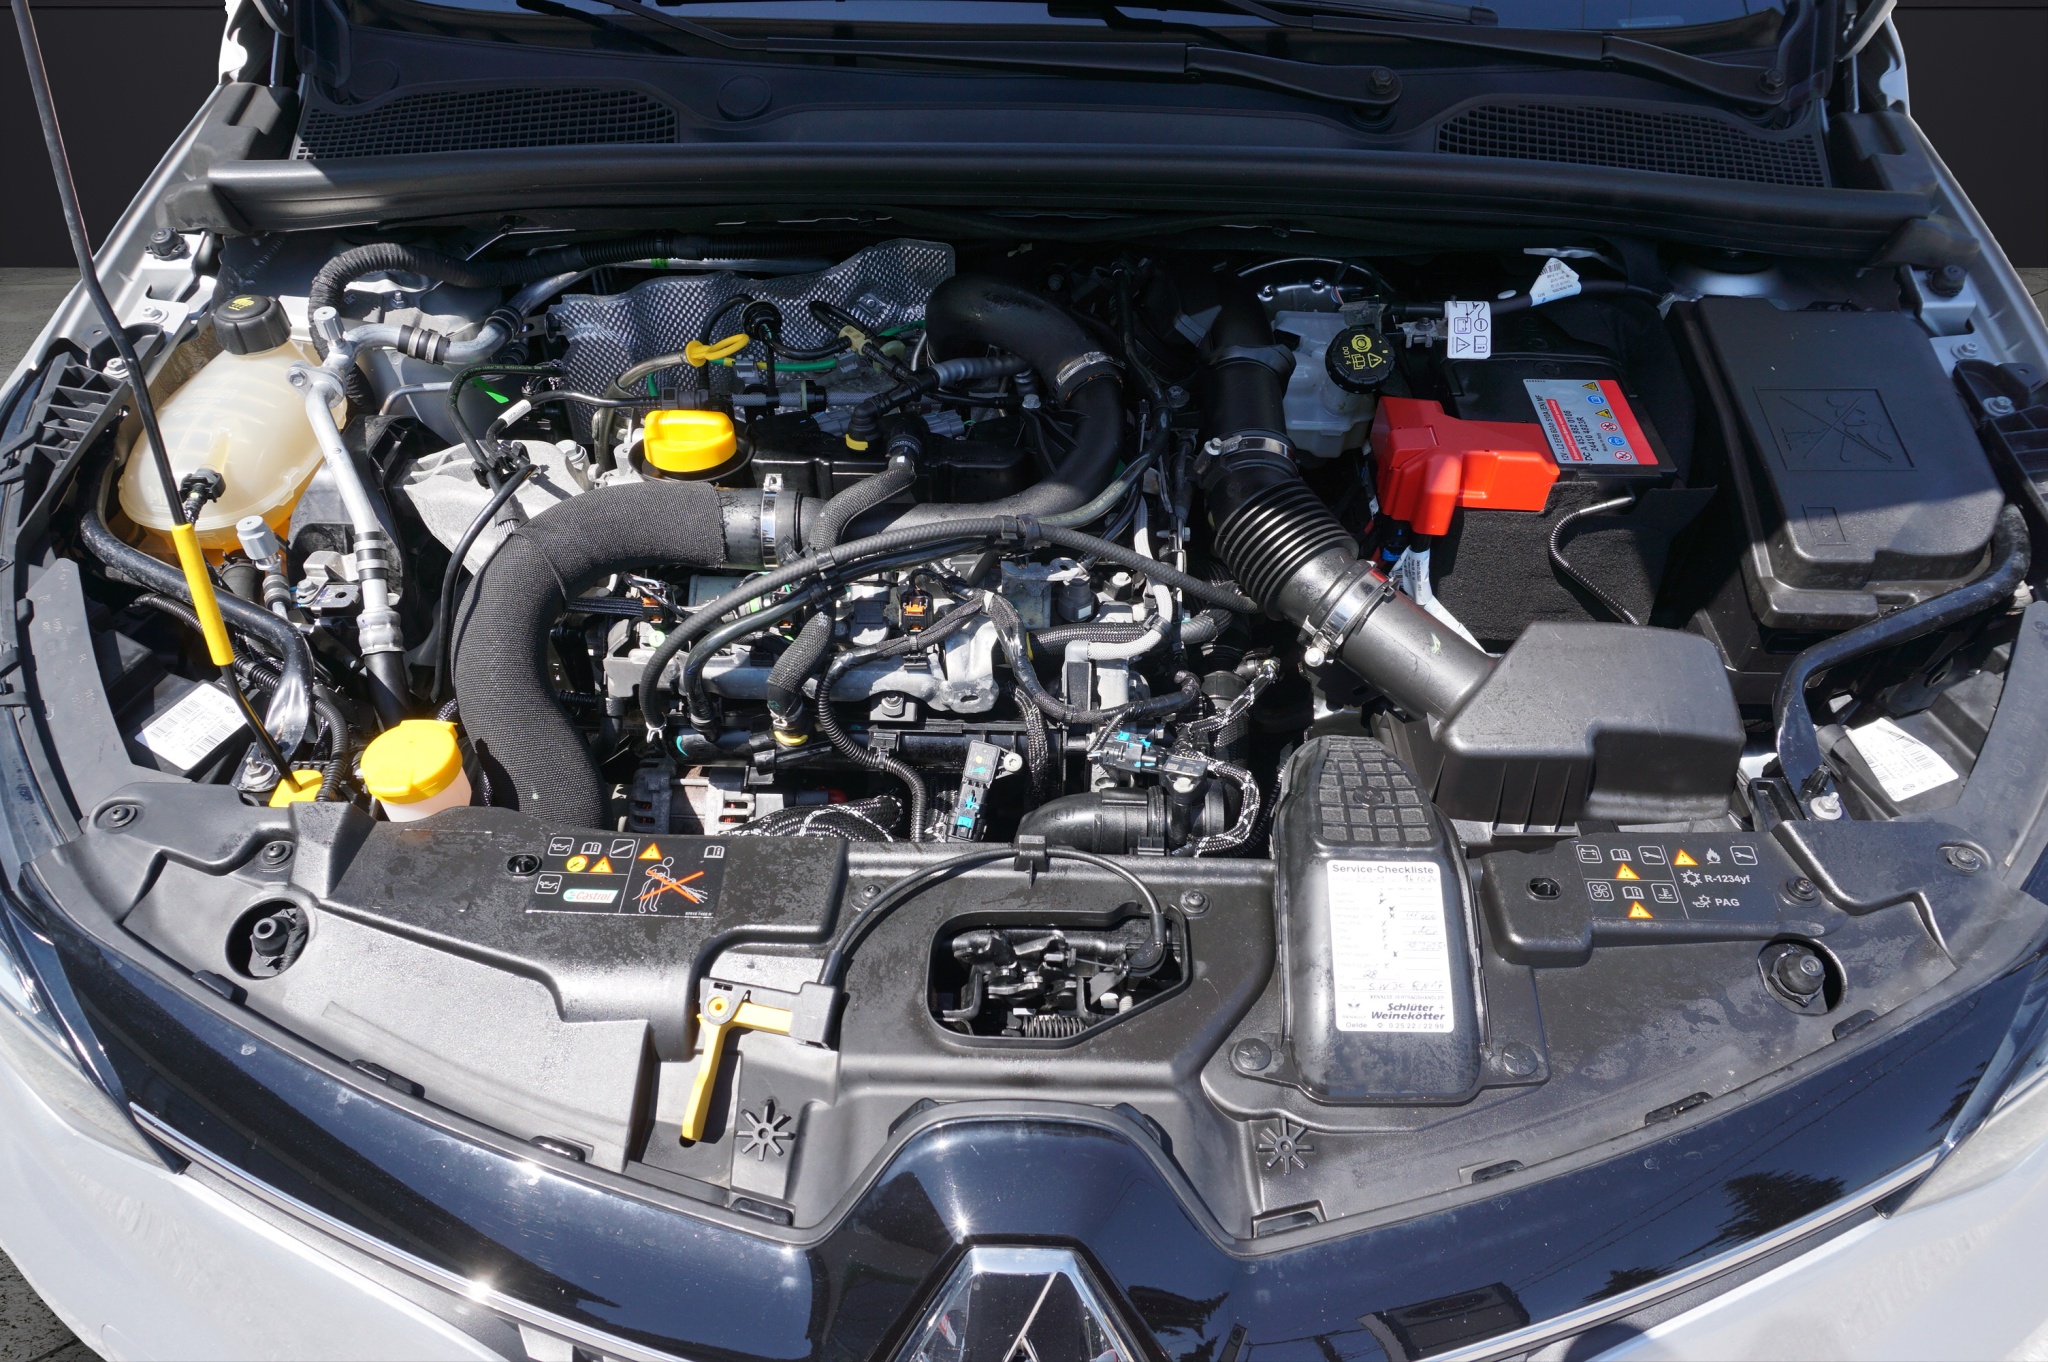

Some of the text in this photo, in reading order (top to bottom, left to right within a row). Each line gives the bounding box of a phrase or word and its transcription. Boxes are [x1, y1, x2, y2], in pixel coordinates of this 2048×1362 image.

[1551, 434, 1562, 442] EFB
[1582, 452, 1593, 461] DC
[1333, 864, 1434, 873] Service-Checkliste
[1705, 874, 1750, 884] R-1234yf
[576, 891, 612, 900] Castrol
[1716, 898, 1740, 907] PAG
[1387, 1003, 1434, 1012] Schlüter
[1371, 1011, 1445, 1020] Weinekötter
